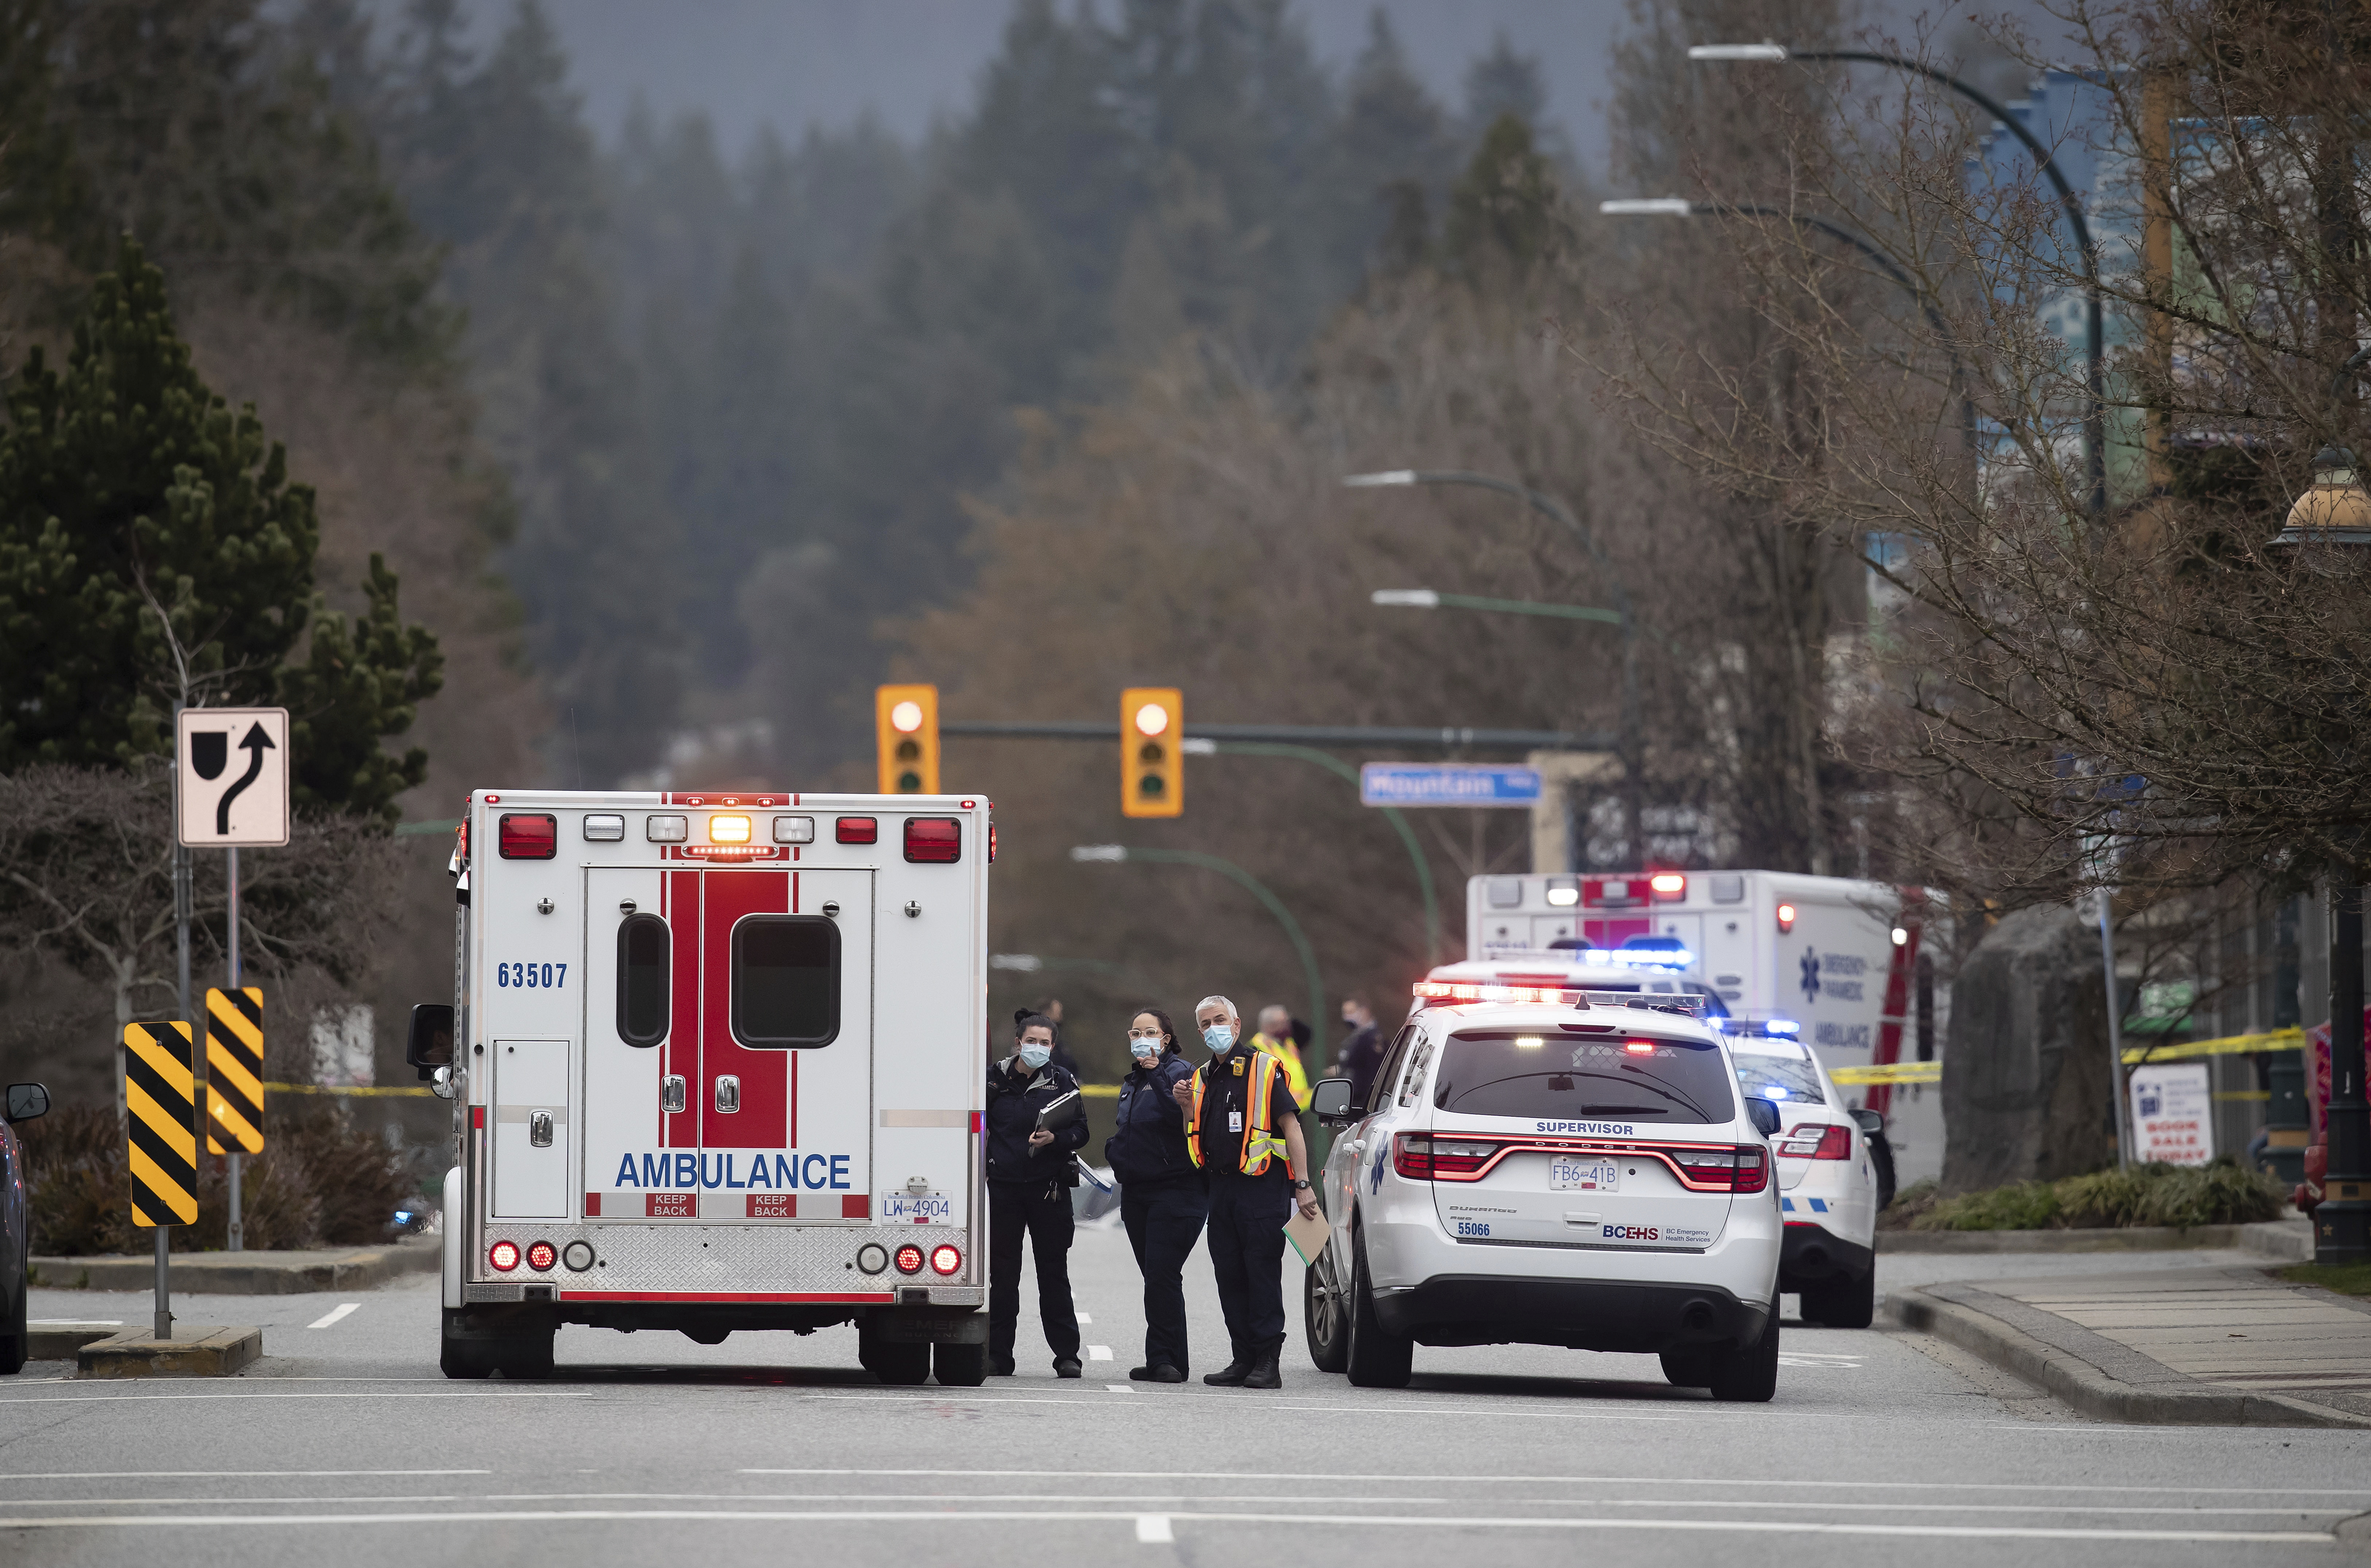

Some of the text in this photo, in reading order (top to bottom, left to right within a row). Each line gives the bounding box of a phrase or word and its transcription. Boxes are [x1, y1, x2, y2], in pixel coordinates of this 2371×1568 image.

[498, 963, 567, 988] 63507
[1536, 1122, 1633, 1135] SUPERVISOR
[1535, 1142, 1636, 1150] DODGE
[615, 1153, 850, 1189] AMBULANCE
[655, 1195, 686, 1204] KEEP
[756, 1196, 787, 1204] KEEP
[654, 1207, 687, 1215] BACK
[755, 1207, 787, 1216] BACK
[1458, 1222, 1490, 1236] 55066
[1603, 1225, 1658, 1240] BCEHS
